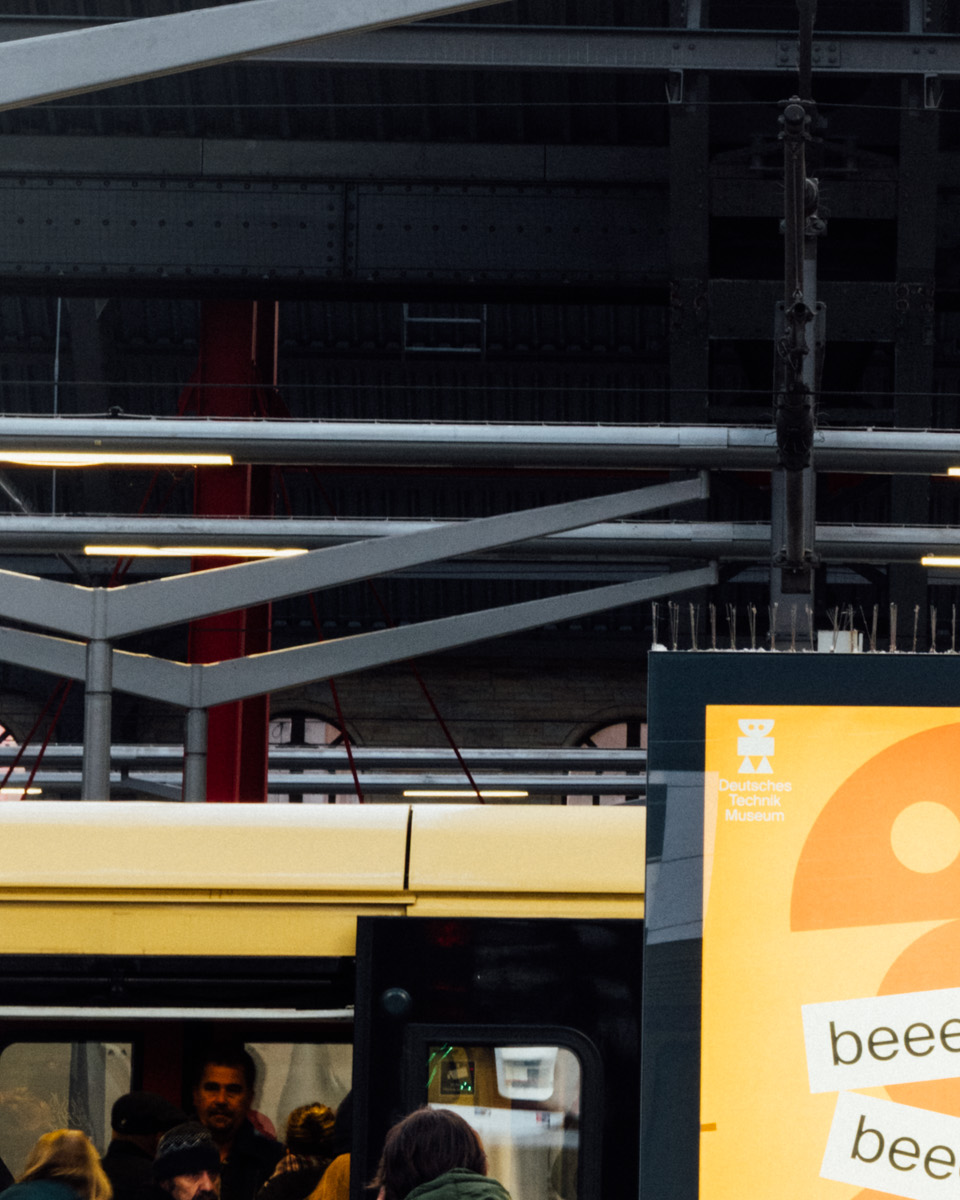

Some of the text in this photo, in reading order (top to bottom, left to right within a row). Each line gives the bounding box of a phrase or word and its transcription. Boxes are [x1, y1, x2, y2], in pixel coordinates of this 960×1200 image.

[719, 779, 792, 792] Deutsches
[728, 793, 782, 807] Technik
[725, 808, 785, 822] Museum
